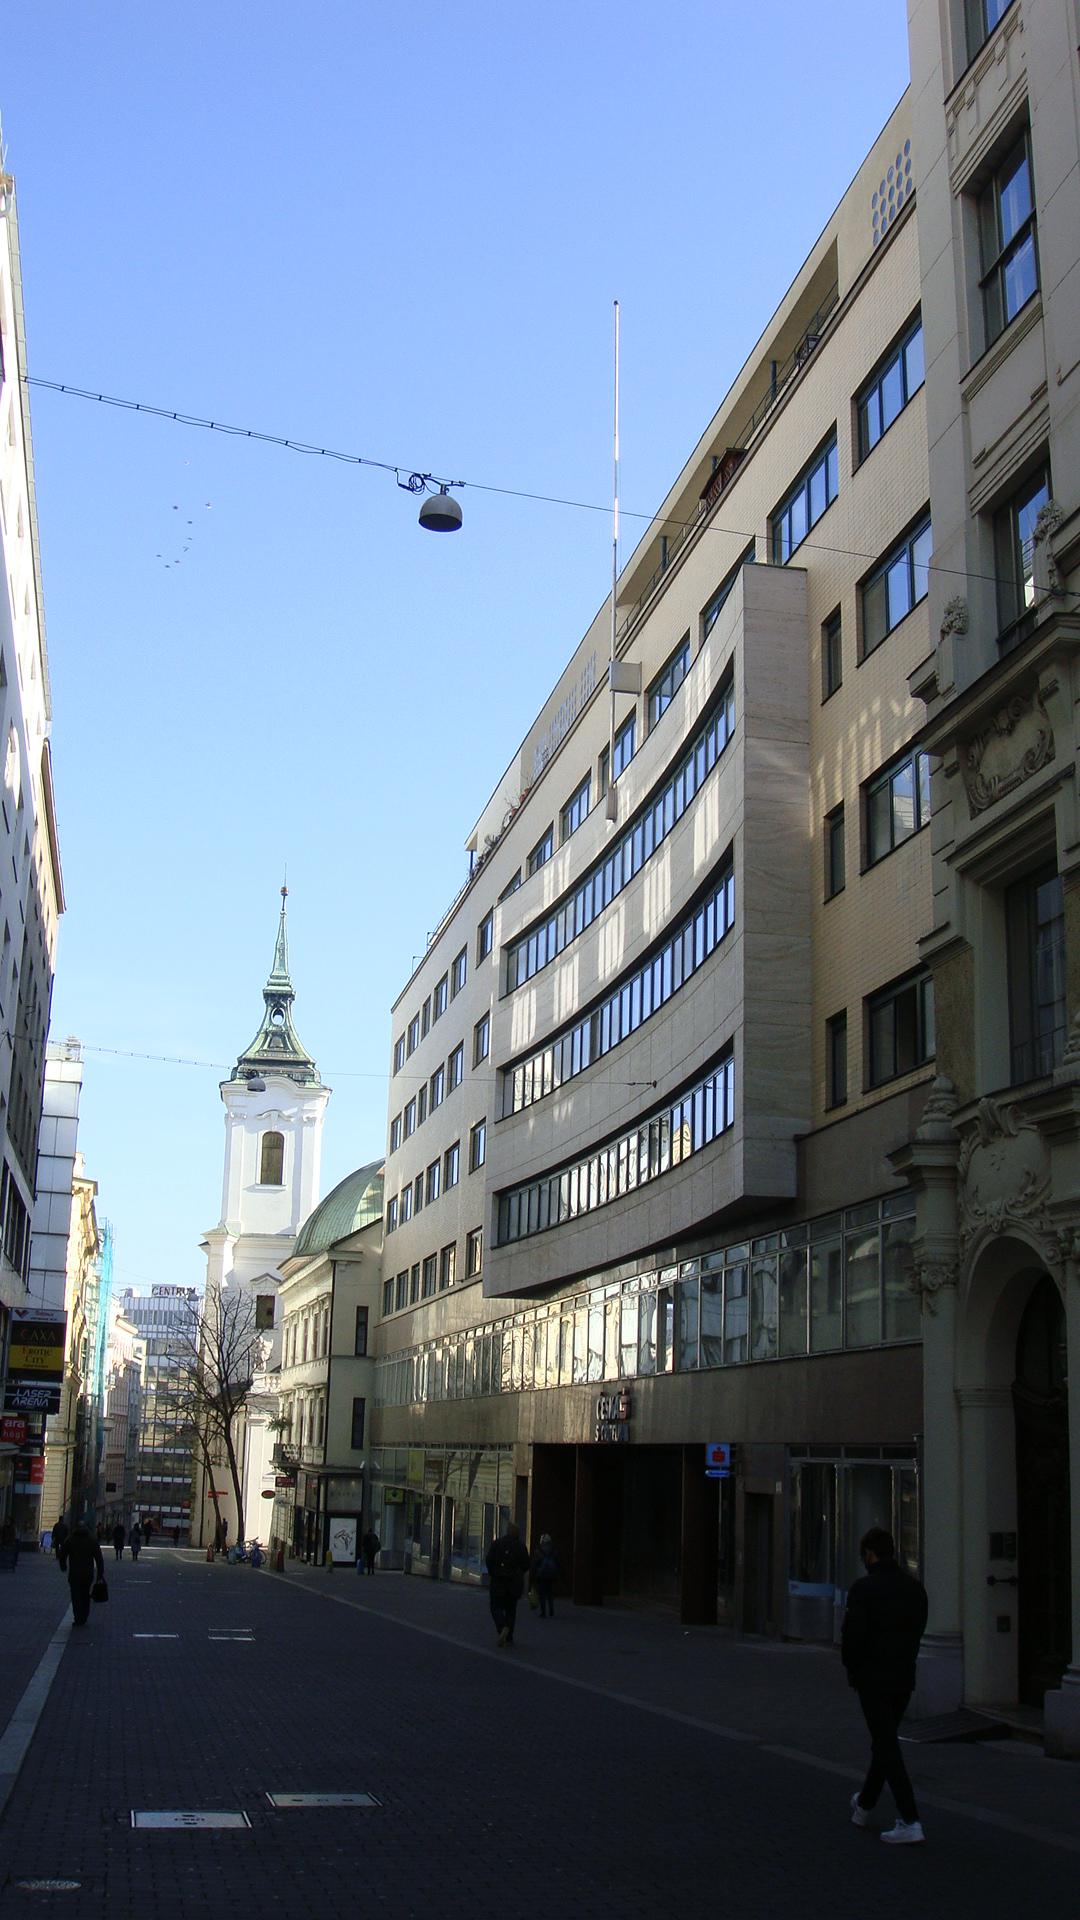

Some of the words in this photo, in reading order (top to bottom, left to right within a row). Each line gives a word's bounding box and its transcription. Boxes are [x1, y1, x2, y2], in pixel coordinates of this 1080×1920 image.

[16, 1388, 52, 1398] LASER
[12, 1397, 49, 1407] ARENA
[4, 1419, 25, 1428] ara
